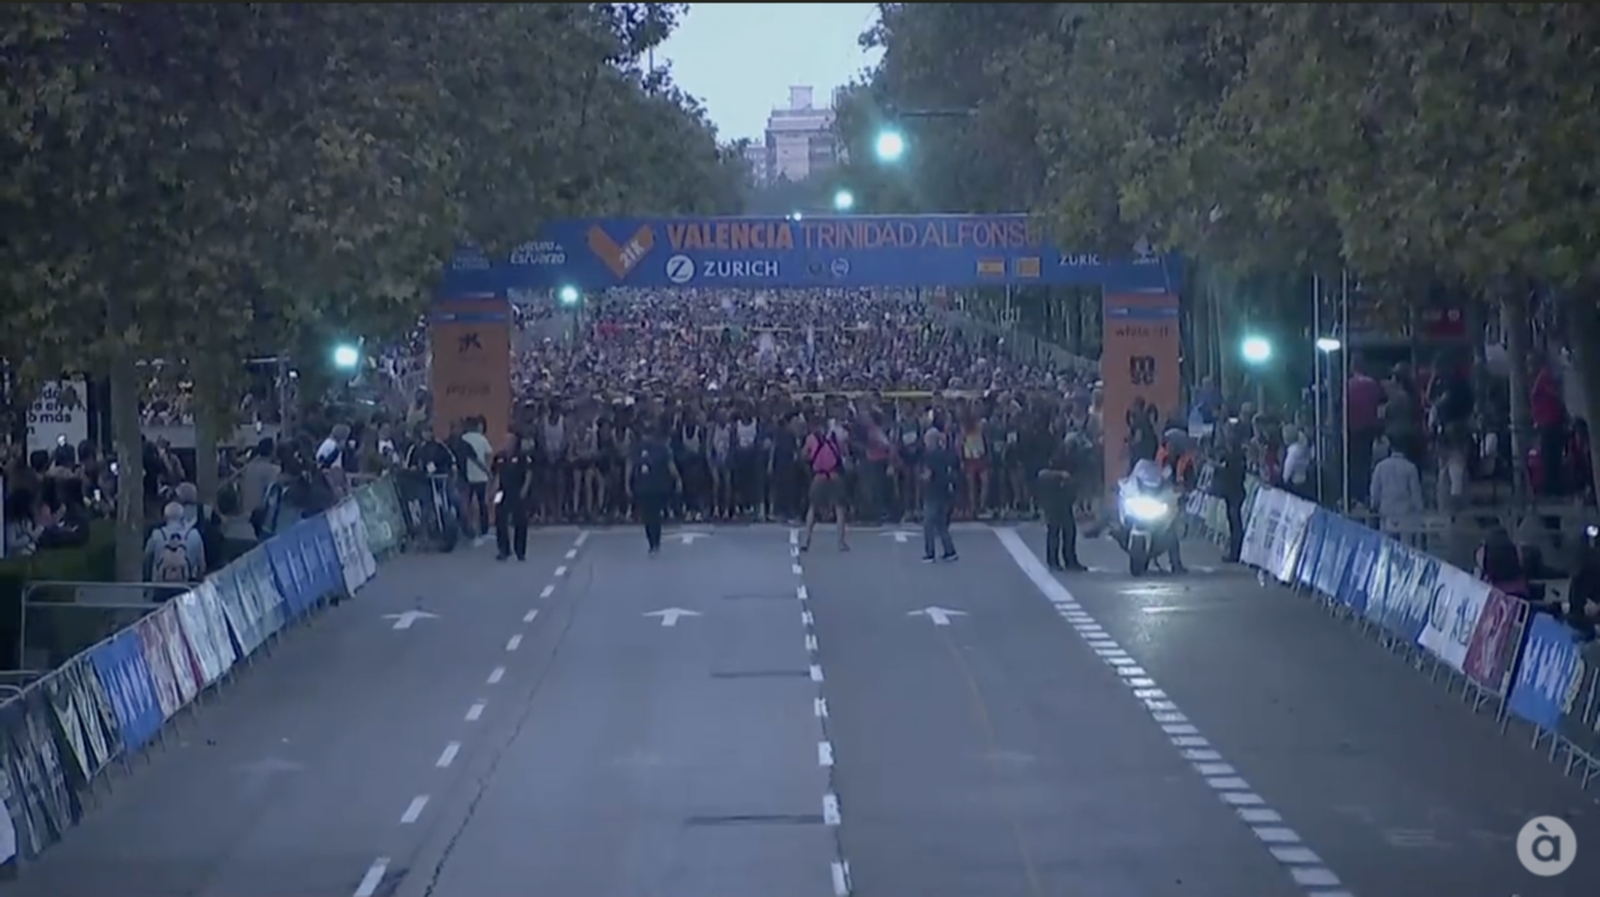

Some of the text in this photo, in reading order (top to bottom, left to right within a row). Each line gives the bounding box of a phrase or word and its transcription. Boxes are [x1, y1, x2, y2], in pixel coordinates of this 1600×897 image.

[666, 222, 794, 249] VALENCIA
[803, 221, 917, 249] TRINIDAD
[619, 239, 646, 269] 21K
[1059, 253, 1106, 266] ZURIC
[703, 260, 779, 277] ZURICH
[40, 409, 72, 423] más
